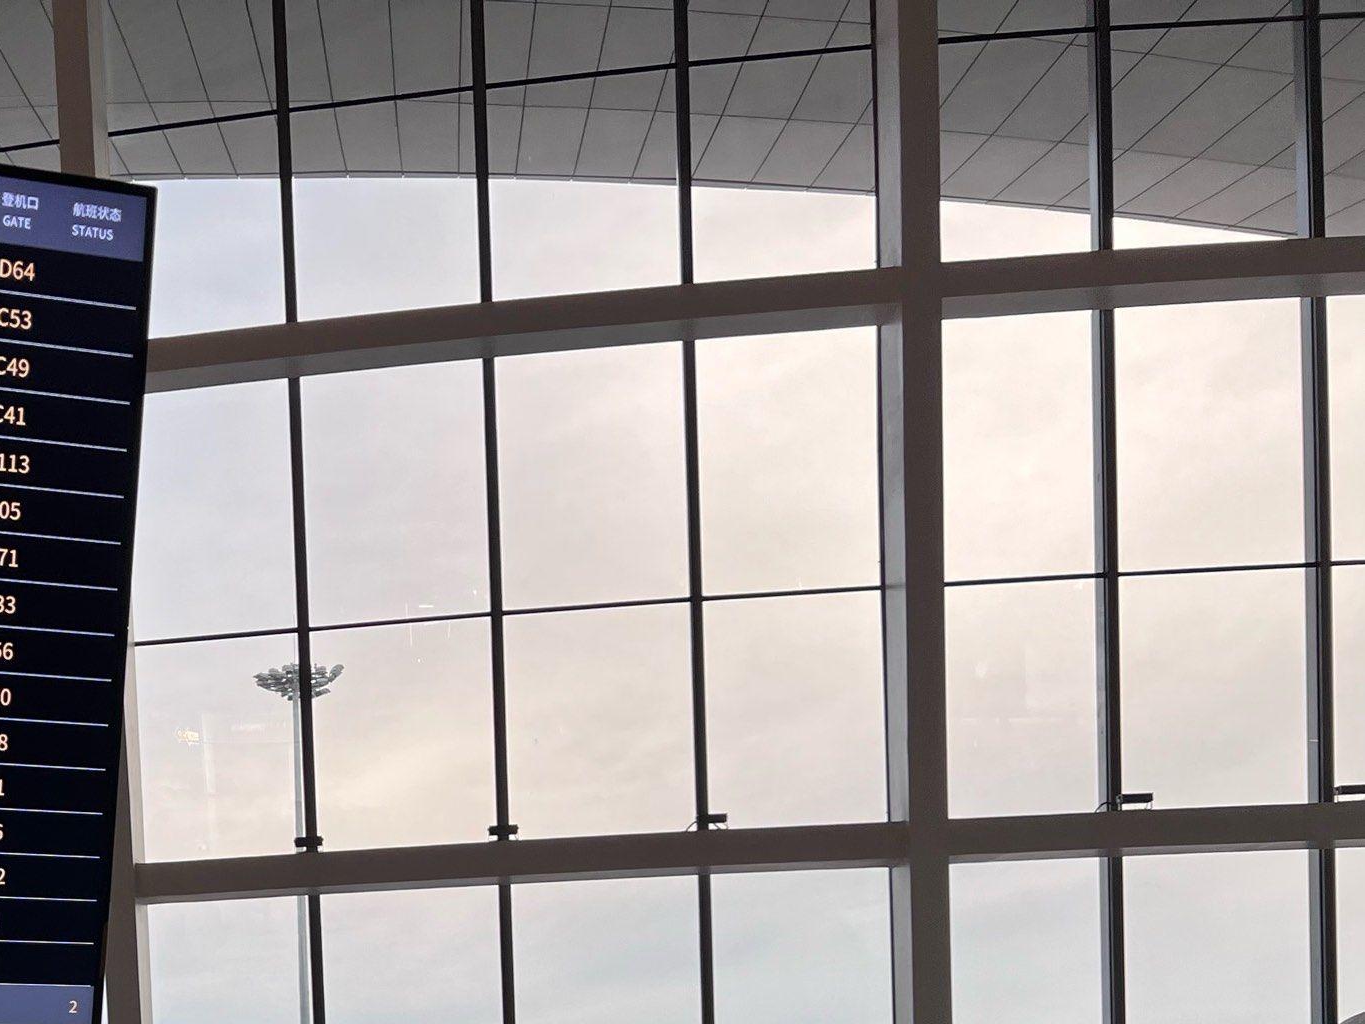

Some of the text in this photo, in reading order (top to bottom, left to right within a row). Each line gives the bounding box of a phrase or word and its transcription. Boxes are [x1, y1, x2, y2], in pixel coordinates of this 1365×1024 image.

[2, 192, 39, 210] 登机口
[73, 203, 121, 222] 航班状态
[3, 215, 31, 230] GATE
[72, 224, 113, 241] STATUS
[0, 259, 35, 281] D64
[69, 1001, 77, 1013] 2
